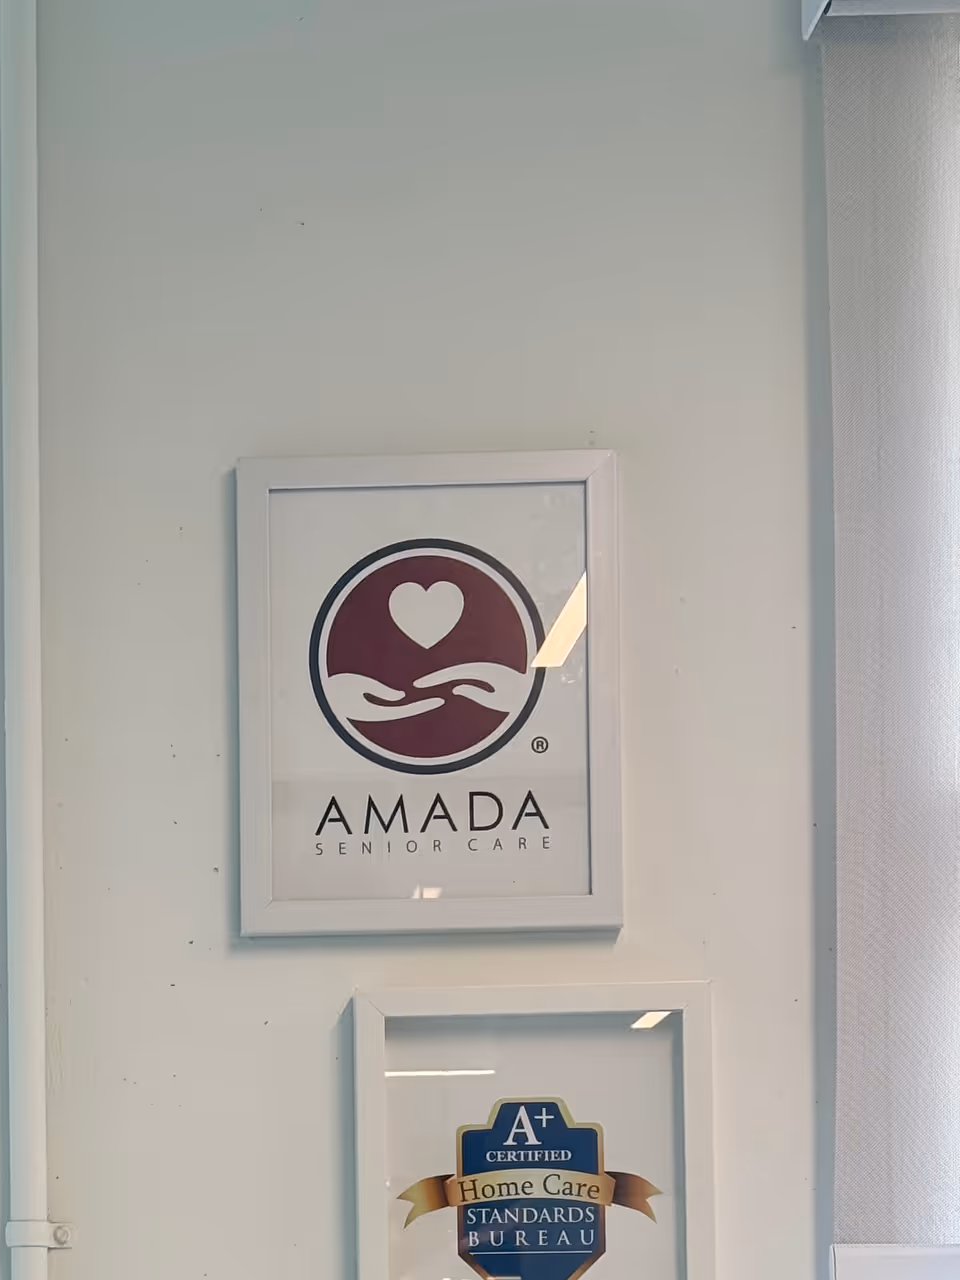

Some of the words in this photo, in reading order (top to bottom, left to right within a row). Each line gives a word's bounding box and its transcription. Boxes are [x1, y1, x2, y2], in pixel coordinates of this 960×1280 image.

[315, 790, 550, 836] AMADA
[315, 840, 442, 855] SENIOR
[468, 836, 551, 851] CARE
[503, 1105, 554, 1146] A+
[486, 1150, 572, 1162] CERTIFIED
[458, 1178, 534, 1202] Home
[543, 1174, 600, 1199] Care
[466, 1206, 595, 1224] STANDARDS
[467, 1229, 595, 1247] BUREAU
